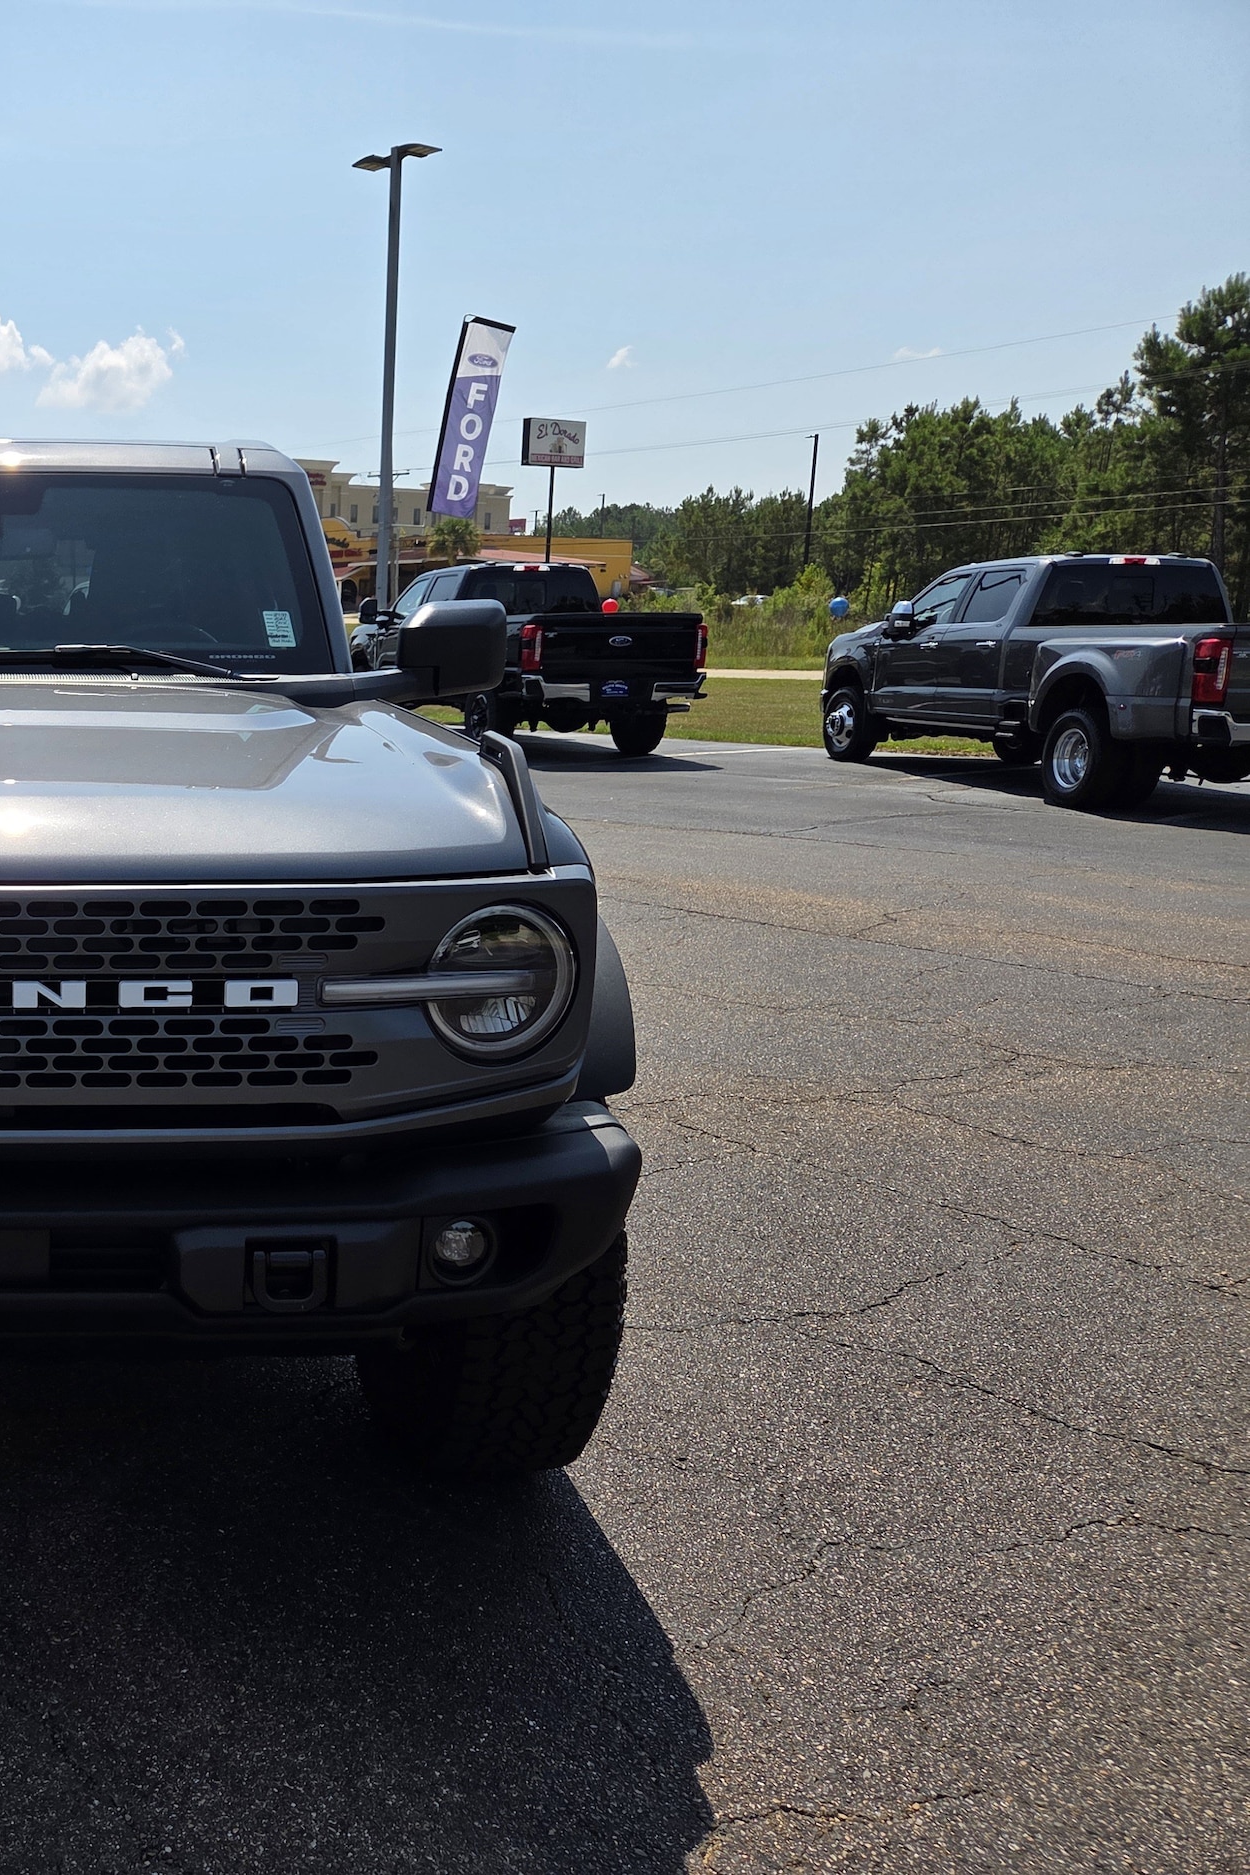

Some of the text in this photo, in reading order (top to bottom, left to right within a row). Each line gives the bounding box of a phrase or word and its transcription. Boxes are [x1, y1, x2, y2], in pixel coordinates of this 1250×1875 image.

[472, 353, 494, 367] Ford
[446, 382, 489, 502] FORD
[536, 421, 580, 445] El Dorado
